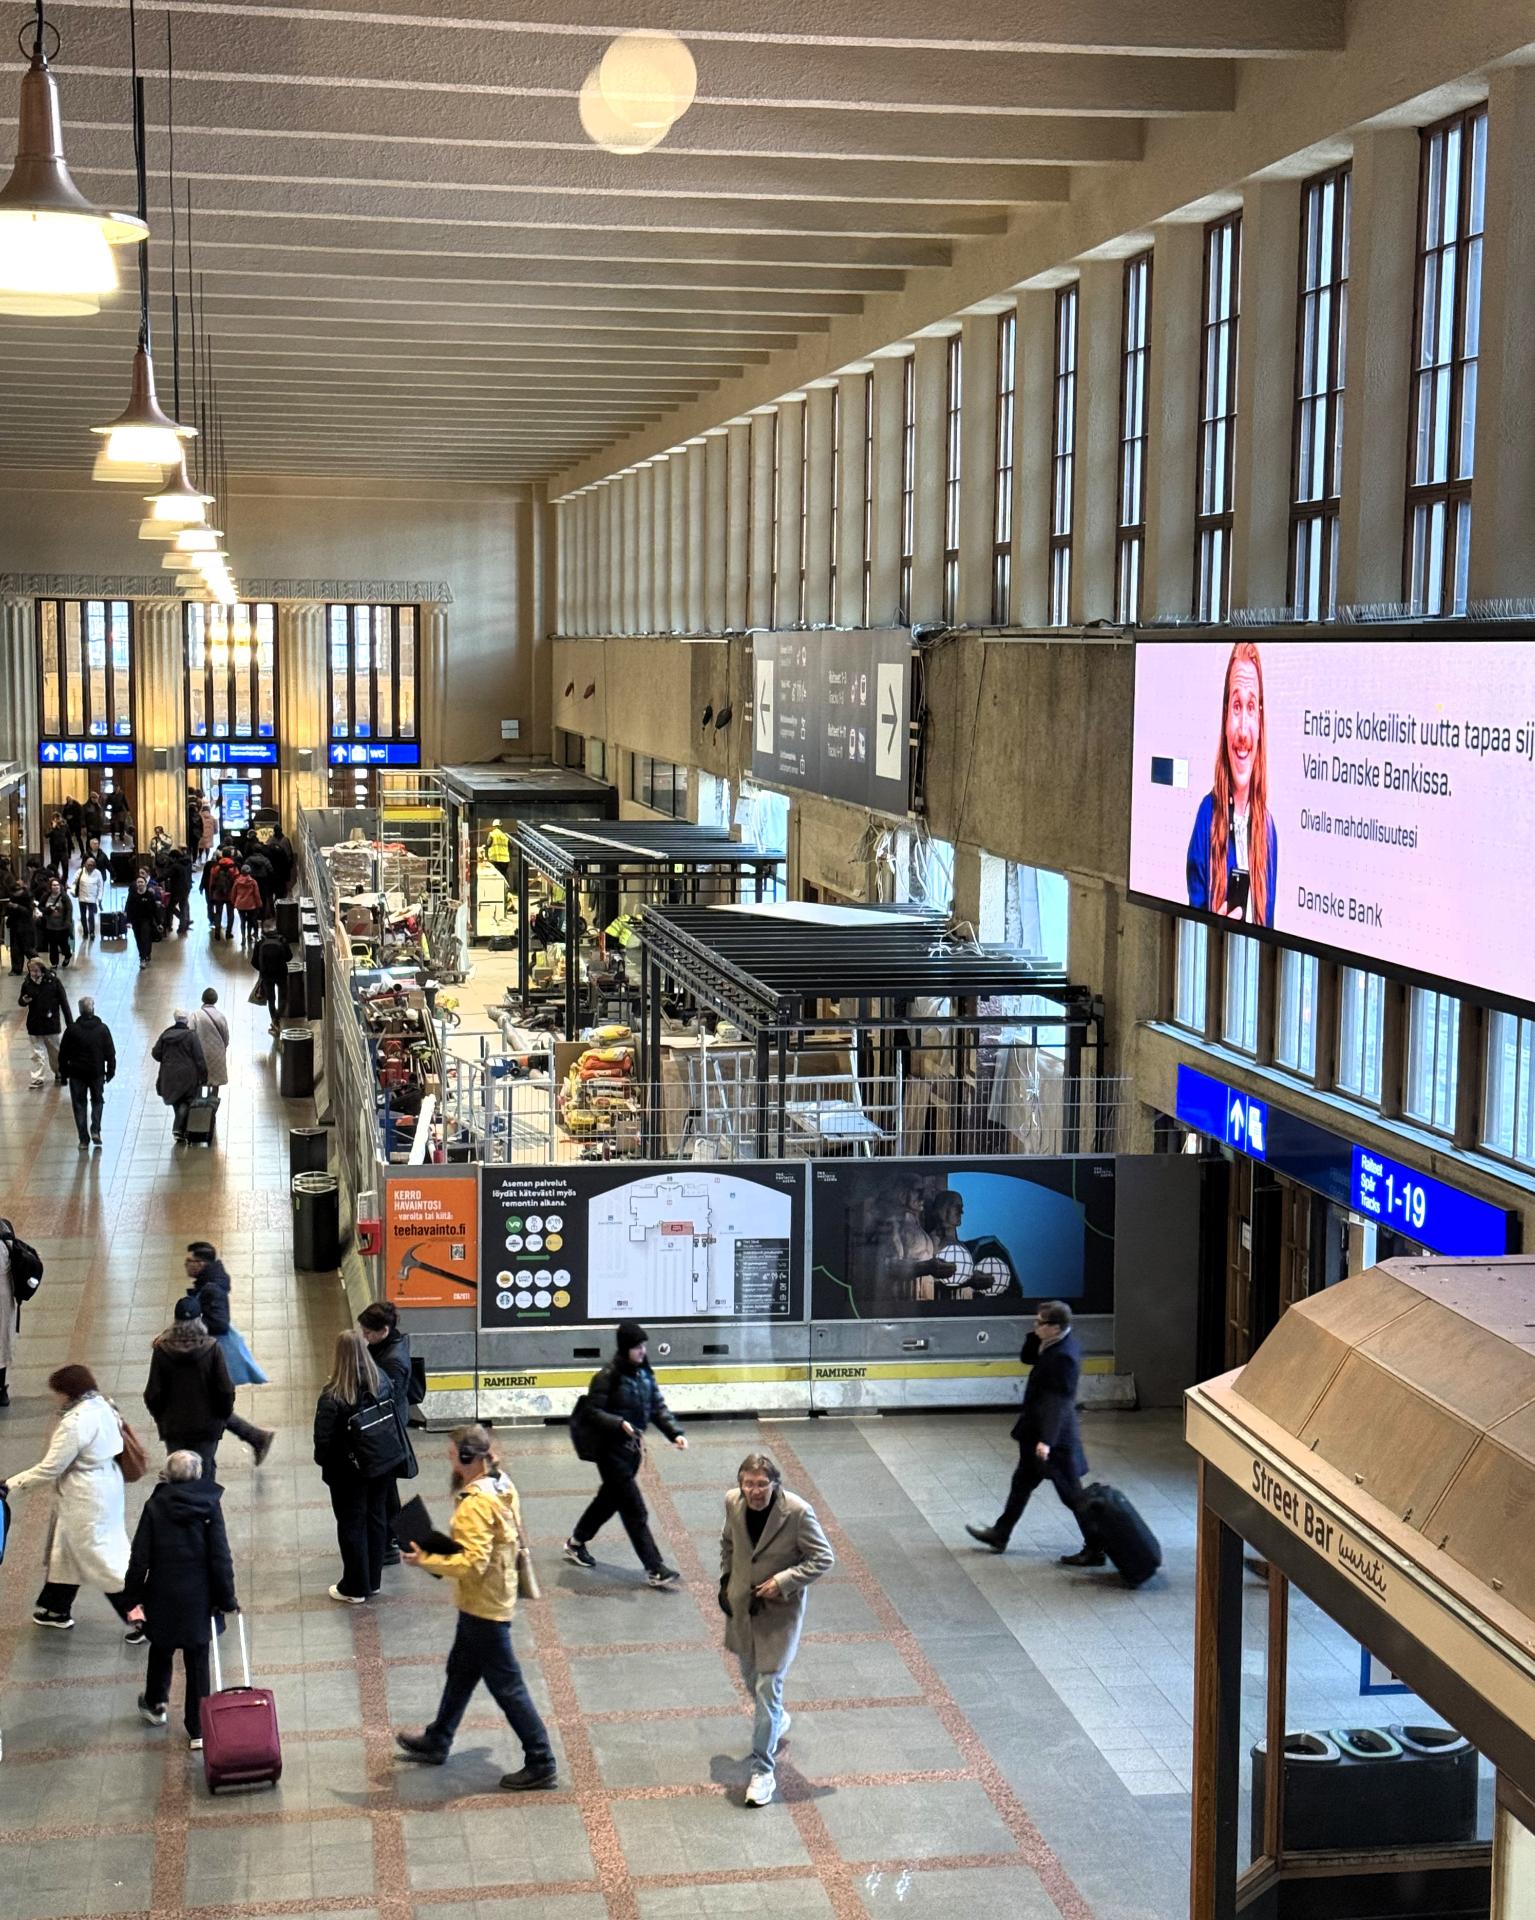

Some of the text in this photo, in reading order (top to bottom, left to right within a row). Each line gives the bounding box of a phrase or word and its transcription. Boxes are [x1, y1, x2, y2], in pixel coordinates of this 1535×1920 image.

[1303, 709, 1535, 761] Entä jos kokeilisit uutta tapaa sij
[370, 749, 386, 759] WC
[1302, 752, 1452, 797] Vain Danske Bankissa.
[1300, 808, 1418, 849] Oivalla mahdollisuutesi
[1297, 886, 1383, 928] Danske Bank
[1361, 1153, 1384, 1178] Raiteet
[502, 1179, 567, 1189] Aseman palvelut
[394, 1190, 422, 1200] KERRO
[492, 1189, 577, 1200] löydät kätevästi myös
[1385, 1173, 1426, 1229] 1-19
[394, 1201, 442, 1211] HAVAINTOSI
[502, 1199, 567, 1207] remontin aikana.
[1359, 1190, 1381, 1215] Tracks
[394, 1223, 466, 1237] teehavainto.fi
[815, 1367, 867, 1378] RAMIRENT
[483, 1376, 538, 1387] RAMIRENT
[1252, 1460, 1299, 1527] Street
[1304, 1501, 1334, 1553] Bar
